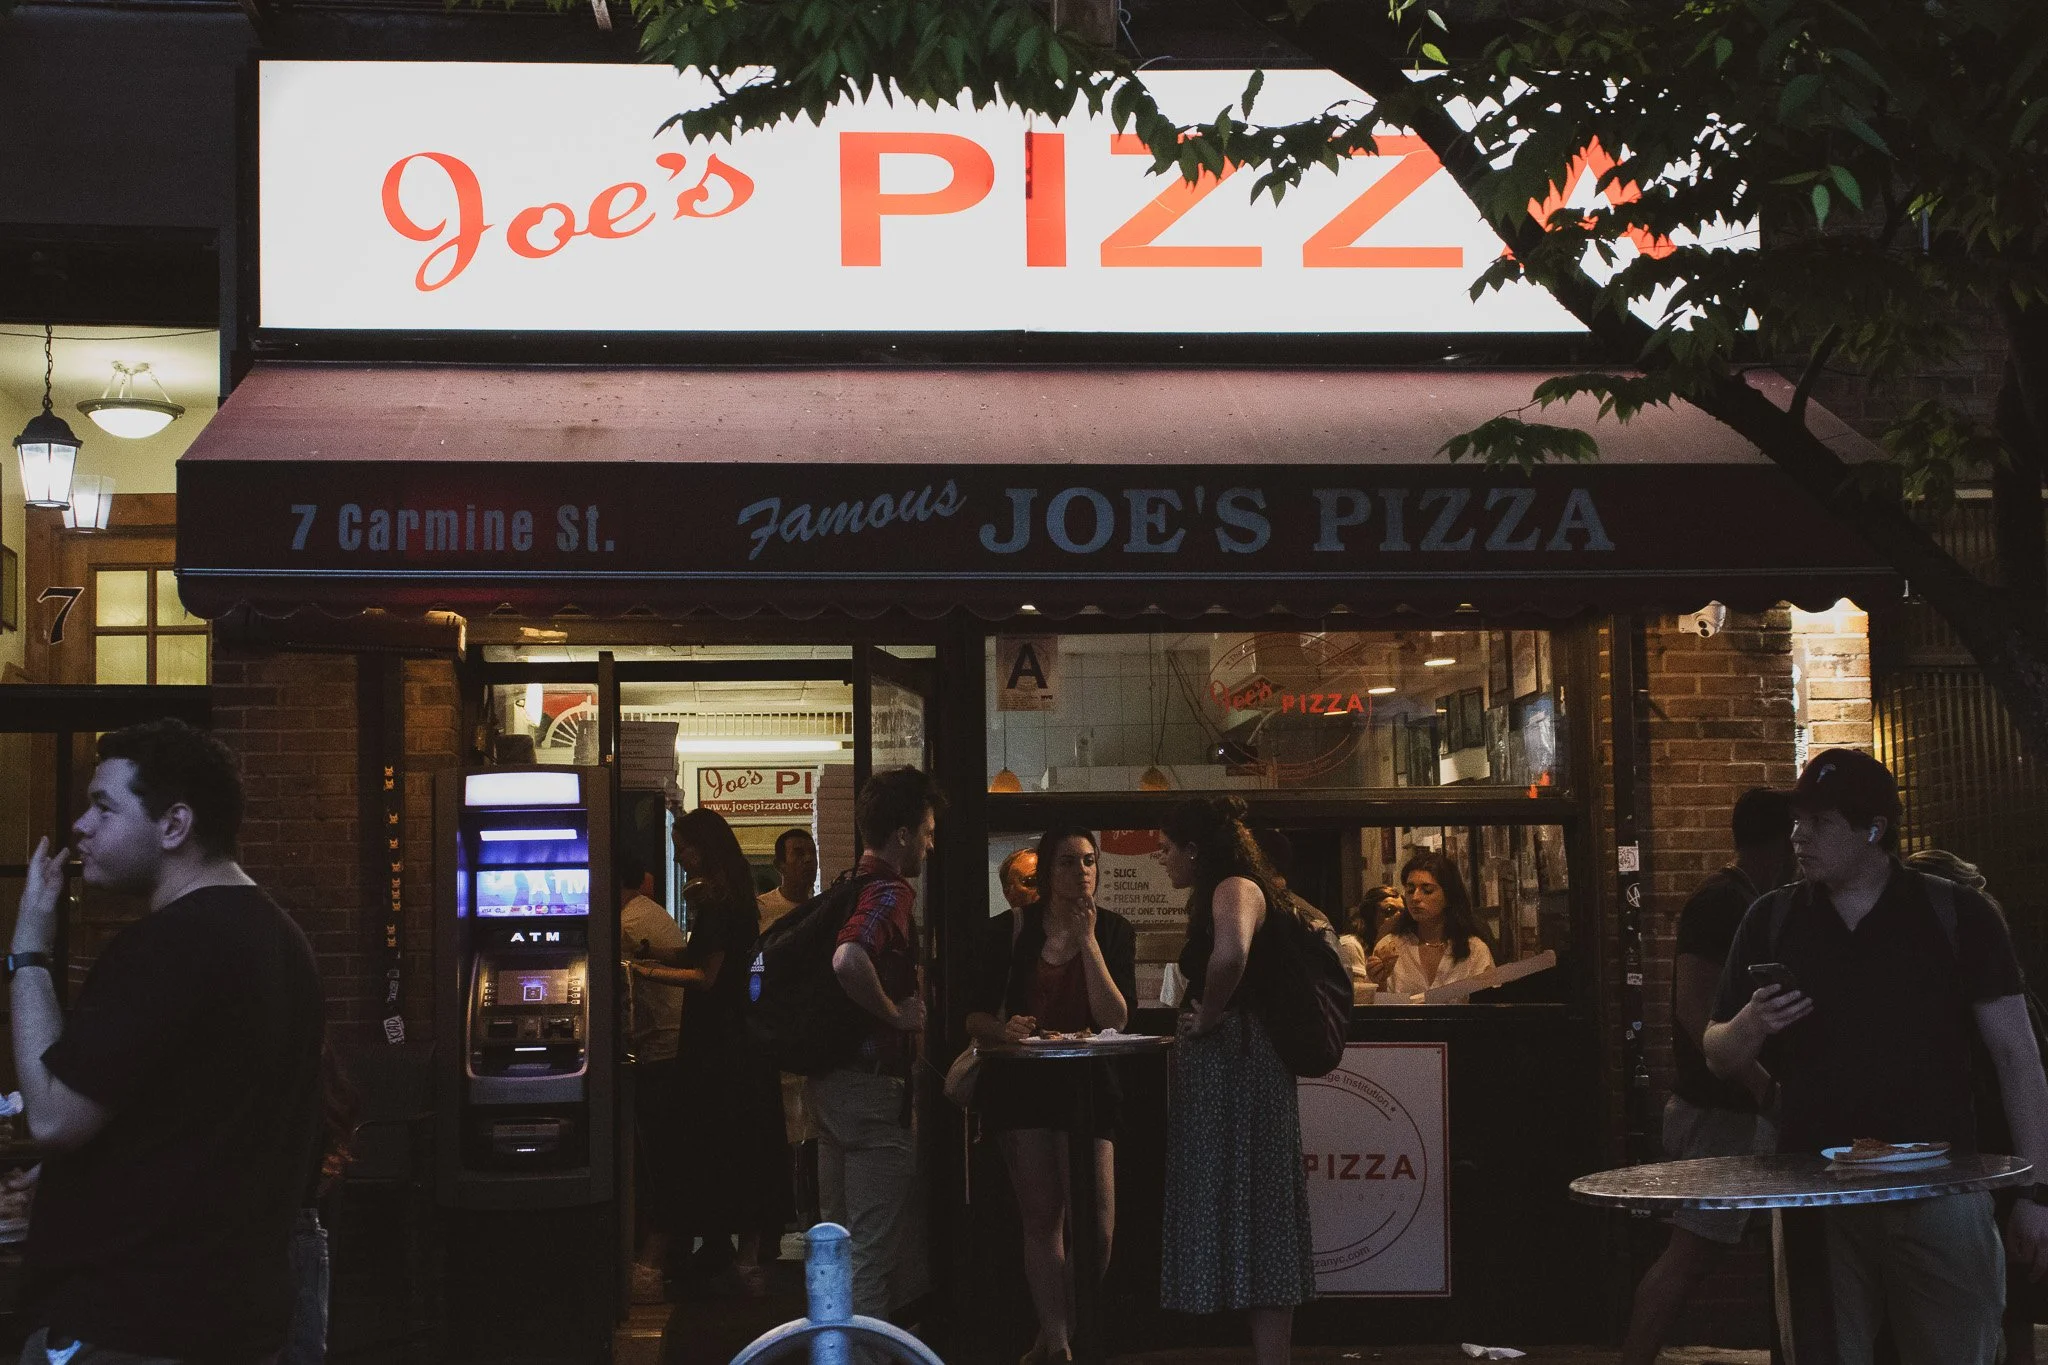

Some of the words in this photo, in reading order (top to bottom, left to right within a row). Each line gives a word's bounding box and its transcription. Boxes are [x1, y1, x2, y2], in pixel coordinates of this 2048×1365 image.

[381, 152, 755, 292] Joe's
[291, 504, 318, 551] 7
[338, 503, 534, 551] Carmine
[556, 504, 615, 551] St.
[737, 478, 968, 560] Famous
[979, 486, 1272, 554] JOE'S
[1311, 487, 1616, 552] PIZZA
[37, 586, 85, 645] 7
[1005, 642, 1049, 689] A
[1281, 691, 1365, 714] PIZZA
[705, 769, 763, 799] Joe's
[703, 801, 814, 813] www.joespizzanyc.co
[1113, 868, 1137, 878] SLICE
[1113, 881, 1149, 890] SICILIAN
[1113, 894, 1140, 904] FRESH
[1138, 907, 1154, 916] ONE
[1156, 907, 1188, 916] TOPPIN
[510, 931, 560, 942] ATM
[1342, 1075, 1390, 1107] Institution
[1303, 1153, 1417, 1181] PIZZA
